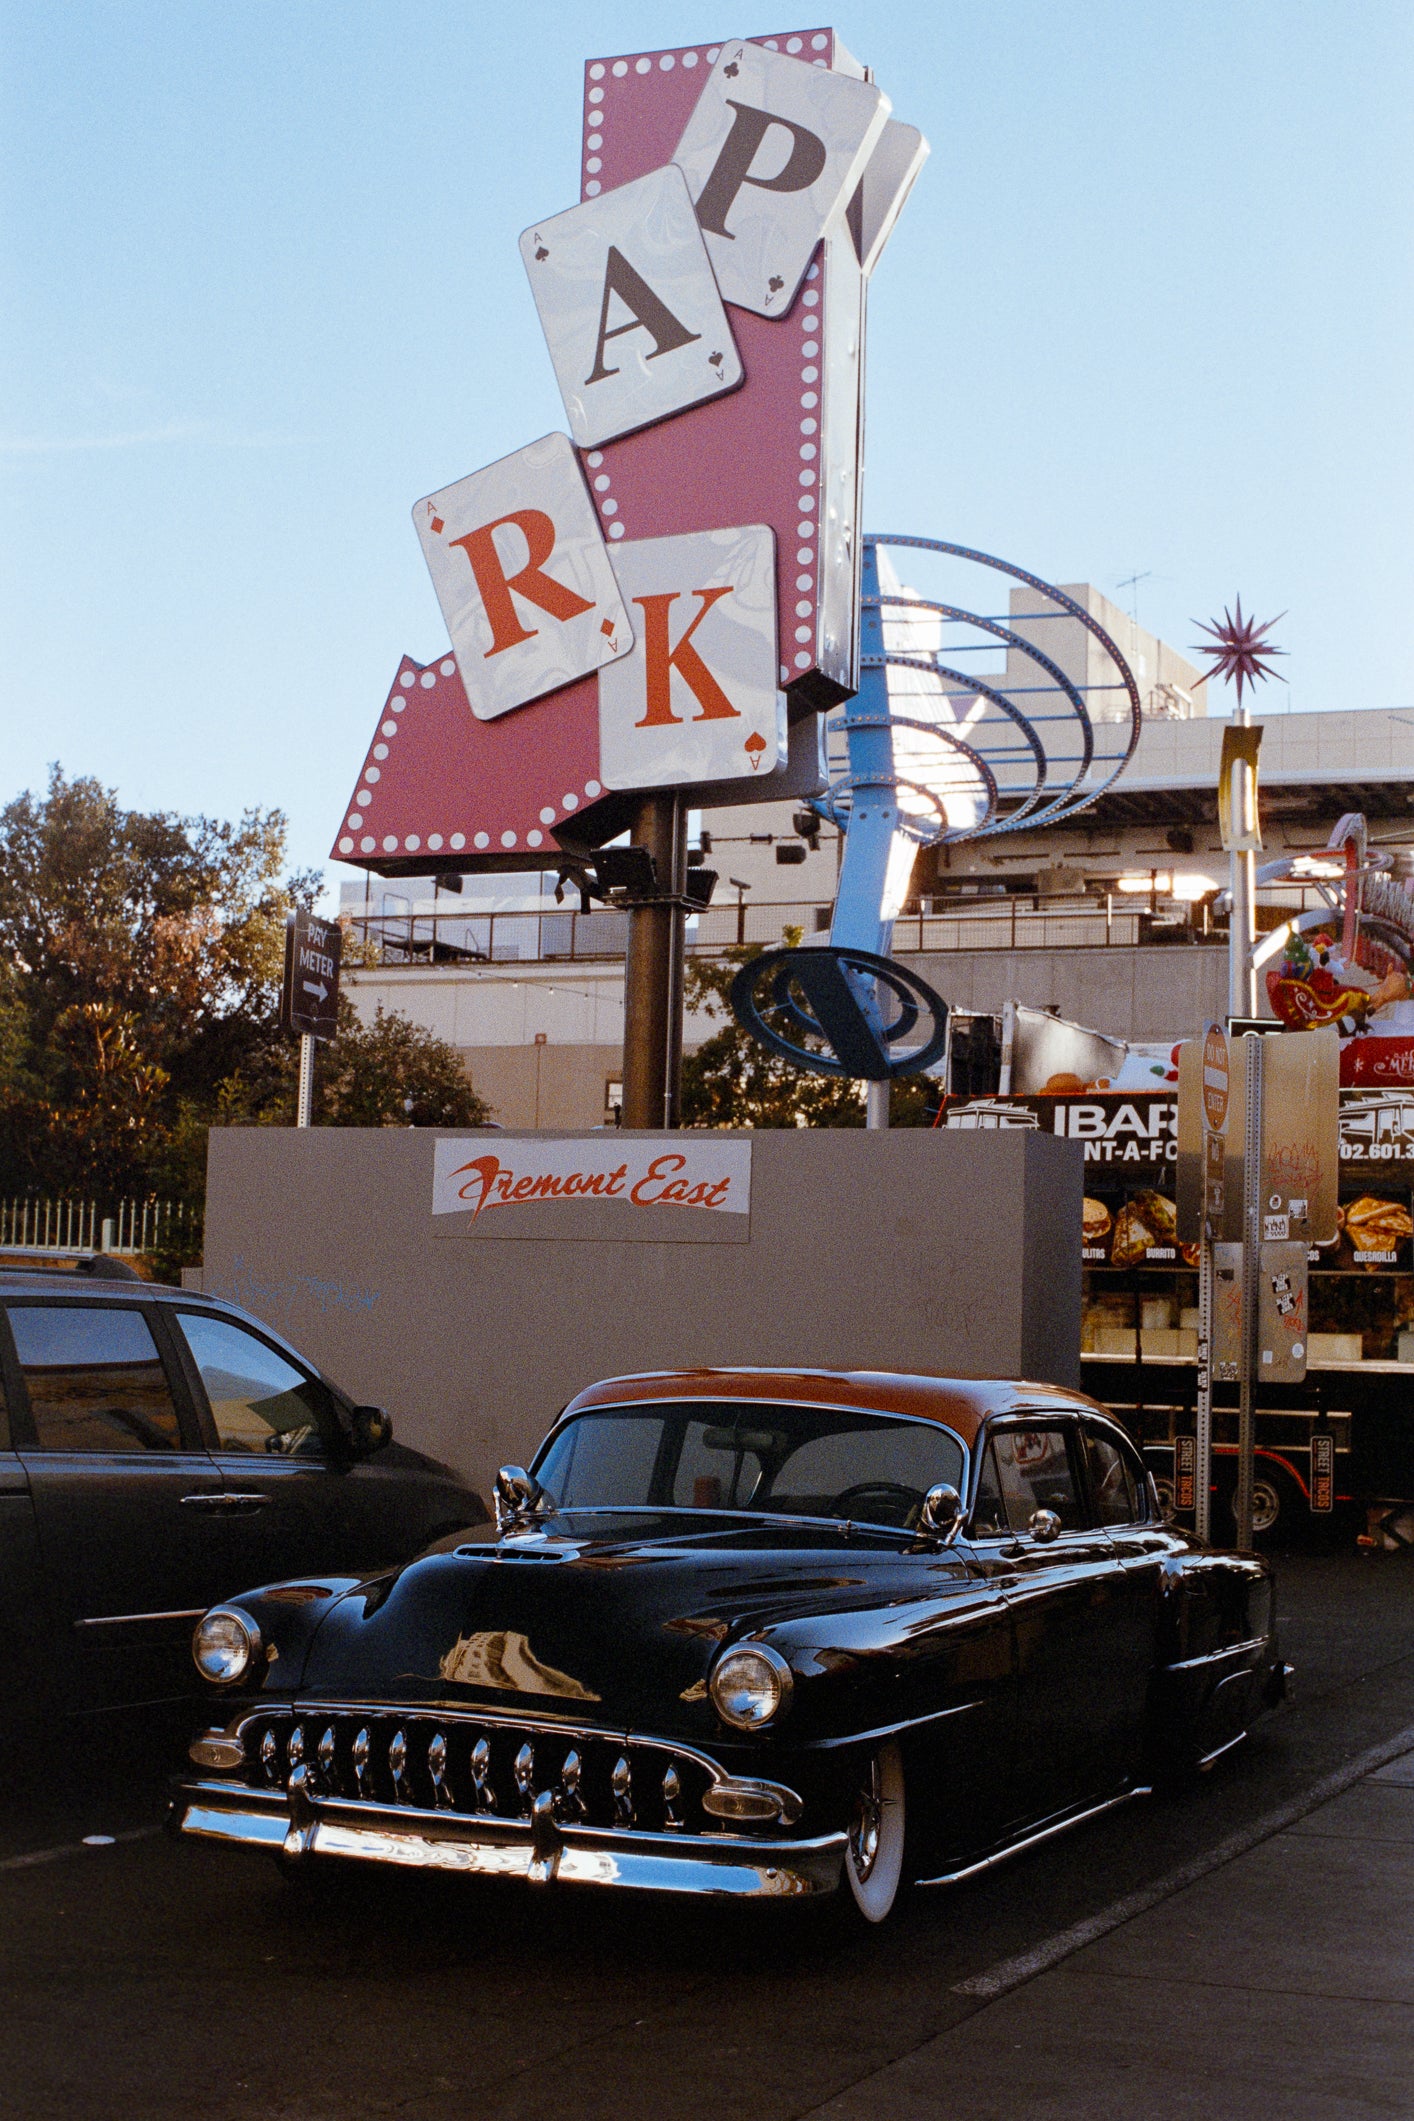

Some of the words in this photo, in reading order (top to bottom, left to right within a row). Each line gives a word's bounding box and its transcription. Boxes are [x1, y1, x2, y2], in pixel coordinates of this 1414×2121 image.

[308, 922, 329, 948] PAY
[300, 947, 334, 979] METER
[1339, 1143, 1414, 1160] 02.601.3
[447, 1155, 628, 1230] Fremont
[630, 1154, 731, 1207] East
[1146, 1248, 1176, 1259] BURRITO
[1353, 1251, 1397, 1262] QUESADILLA
[1181, 1440, 1193, 1472] STREET
[1317, 1440, 1330, 1473] STREET
[1181, 1476, 1193, 1505] TACOS
[1317, 1477, 1330, 1507] TACOS
